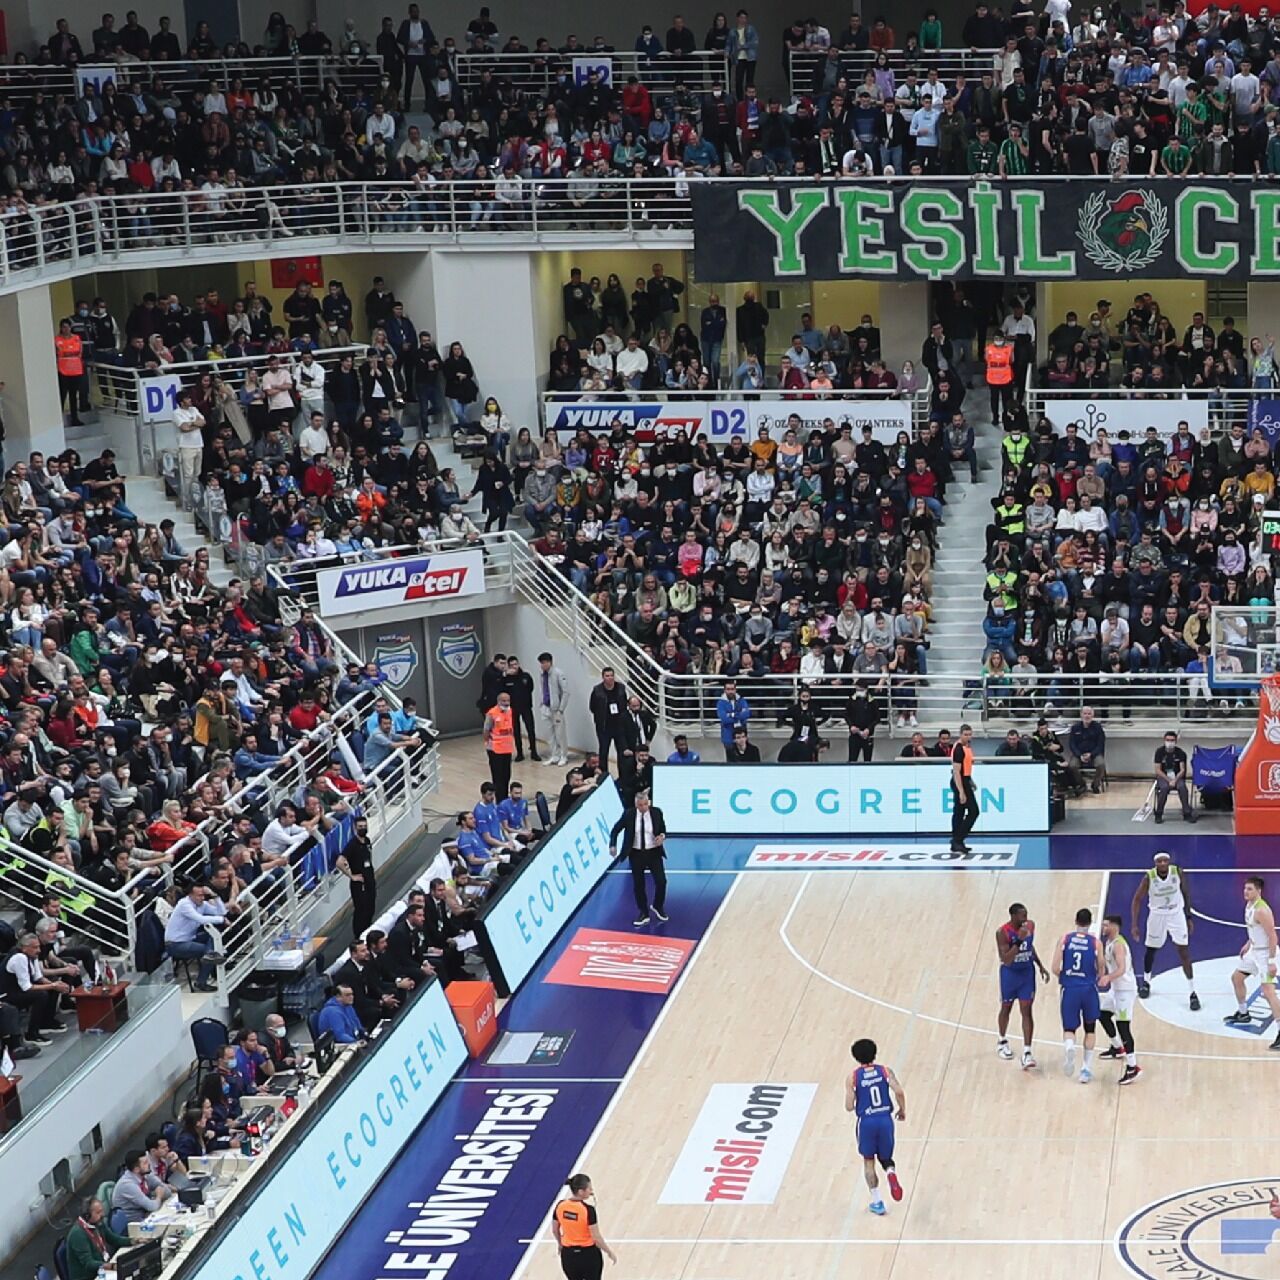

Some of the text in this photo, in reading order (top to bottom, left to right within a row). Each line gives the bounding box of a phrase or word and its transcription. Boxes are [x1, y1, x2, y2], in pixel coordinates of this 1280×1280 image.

[737, 181, 1077, 280] YEŞİL
[145, 384, 178, 413] D1
[566, 410, 693, 439] YUKA tel
[711, 408, 746, 435] D2
[775, 419, 823, 429] OZTEKS
[345, 567, 459, 593] YUKA tel
[755, 849, 1014, 863] misli.com
[514, 812, 612, 944] ECOGREEN
[1072, 951, 1082, 970] 3
[326, 1021, 448, 1190] ECOGREEN
[704, 1085, 788, 1202] misli.com
[384, 1088, 559, 1247] ÜNİVERSİTESİ
